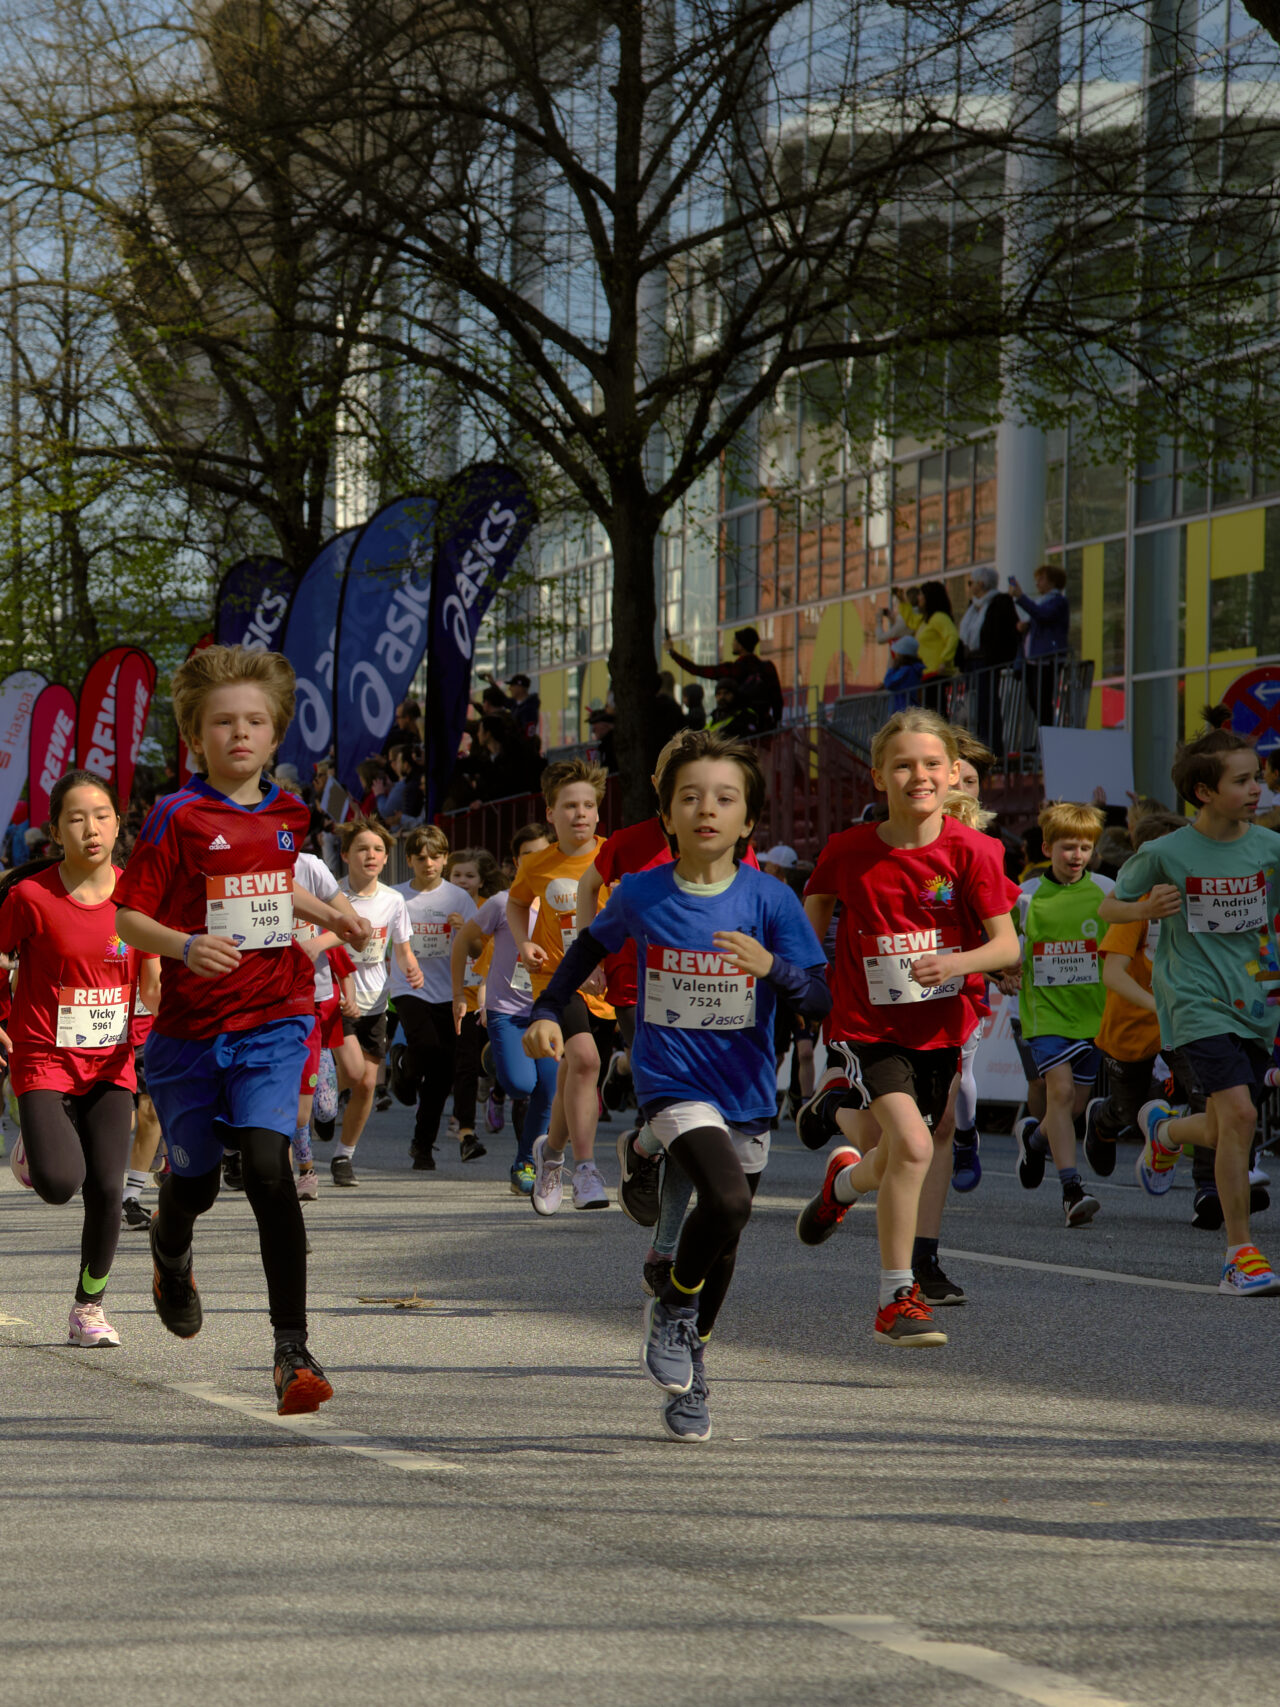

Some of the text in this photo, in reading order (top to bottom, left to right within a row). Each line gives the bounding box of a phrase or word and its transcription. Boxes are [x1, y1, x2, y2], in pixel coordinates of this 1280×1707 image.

[456, 501, 517, 609] asics
[242, 587, 287, 651] sics
[3, 692, 34, 746] Haspa
[39, 709, 74, 795] REWE
[224, 872, 288, 896] REWE
[1201, 875, 1258, 894] REWE
[251, 899, 278, 912] Luis
[1212, 896, 1258, 908] Andrius
[1224, 909, 1249, 918] 6413
[252, 915, 280, 927] 7499
[876, 929, 944, 955] REWE
[1044, 941, 1087, 955] REWE
[663, 949, 739, 974] REWE
[1052, 956, 1084, 966] Florian
[672, 978, 738, 993] Valentin
[932, 984, 956, 996] asics
[73, 987, 123, 1005] REWE
[688, 997, 722, 1008] 7524
[745, 991, 753, 1001] A
[89, 1009, 116, 1020] Vicky
[715, 1014, 744, 1026] asics
[92, 1022, 112, 1031] 5961
